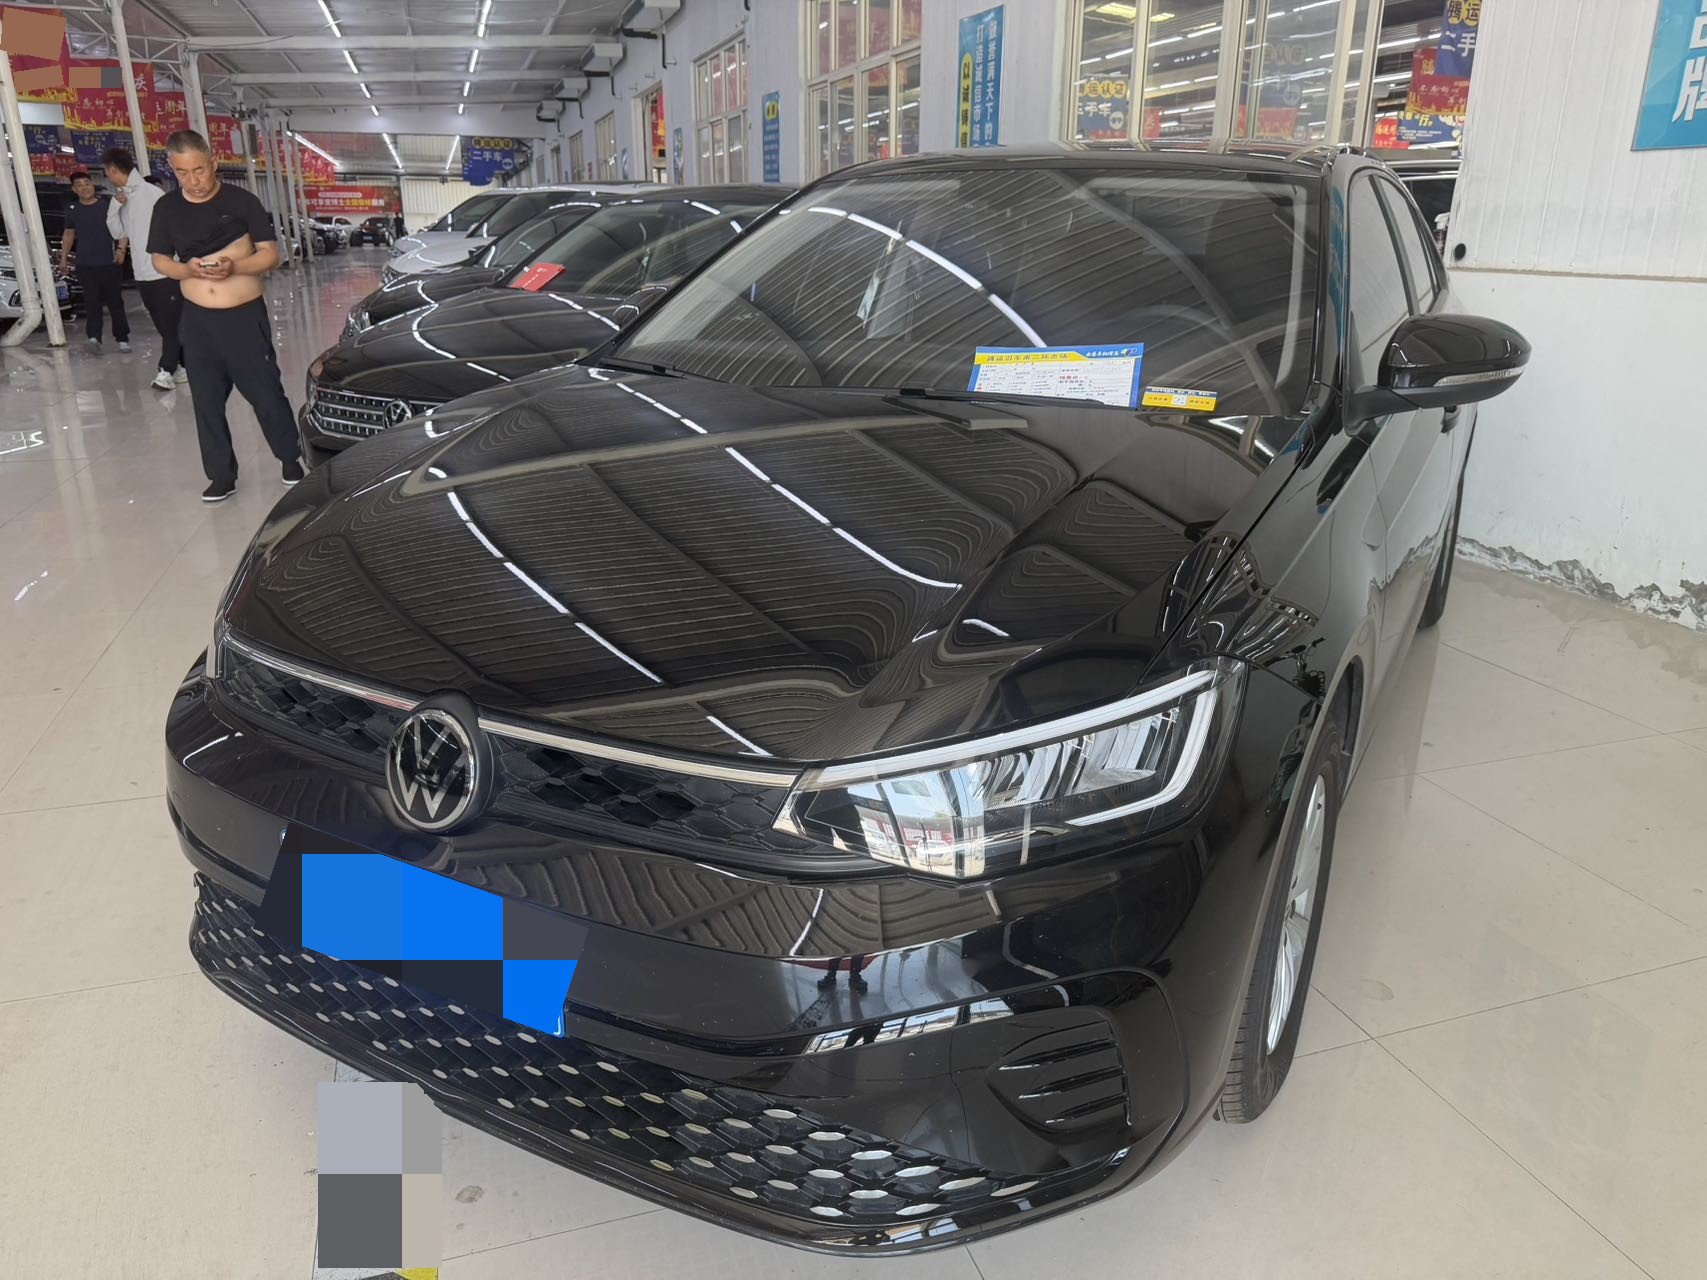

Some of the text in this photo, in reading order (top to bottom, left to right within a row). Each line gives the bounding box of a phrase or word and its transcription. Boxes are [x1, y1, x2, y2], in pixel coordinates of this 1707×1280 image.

[1441, 30, 1476, 57] 二手
[472, 150, 503, 162] 二手车
